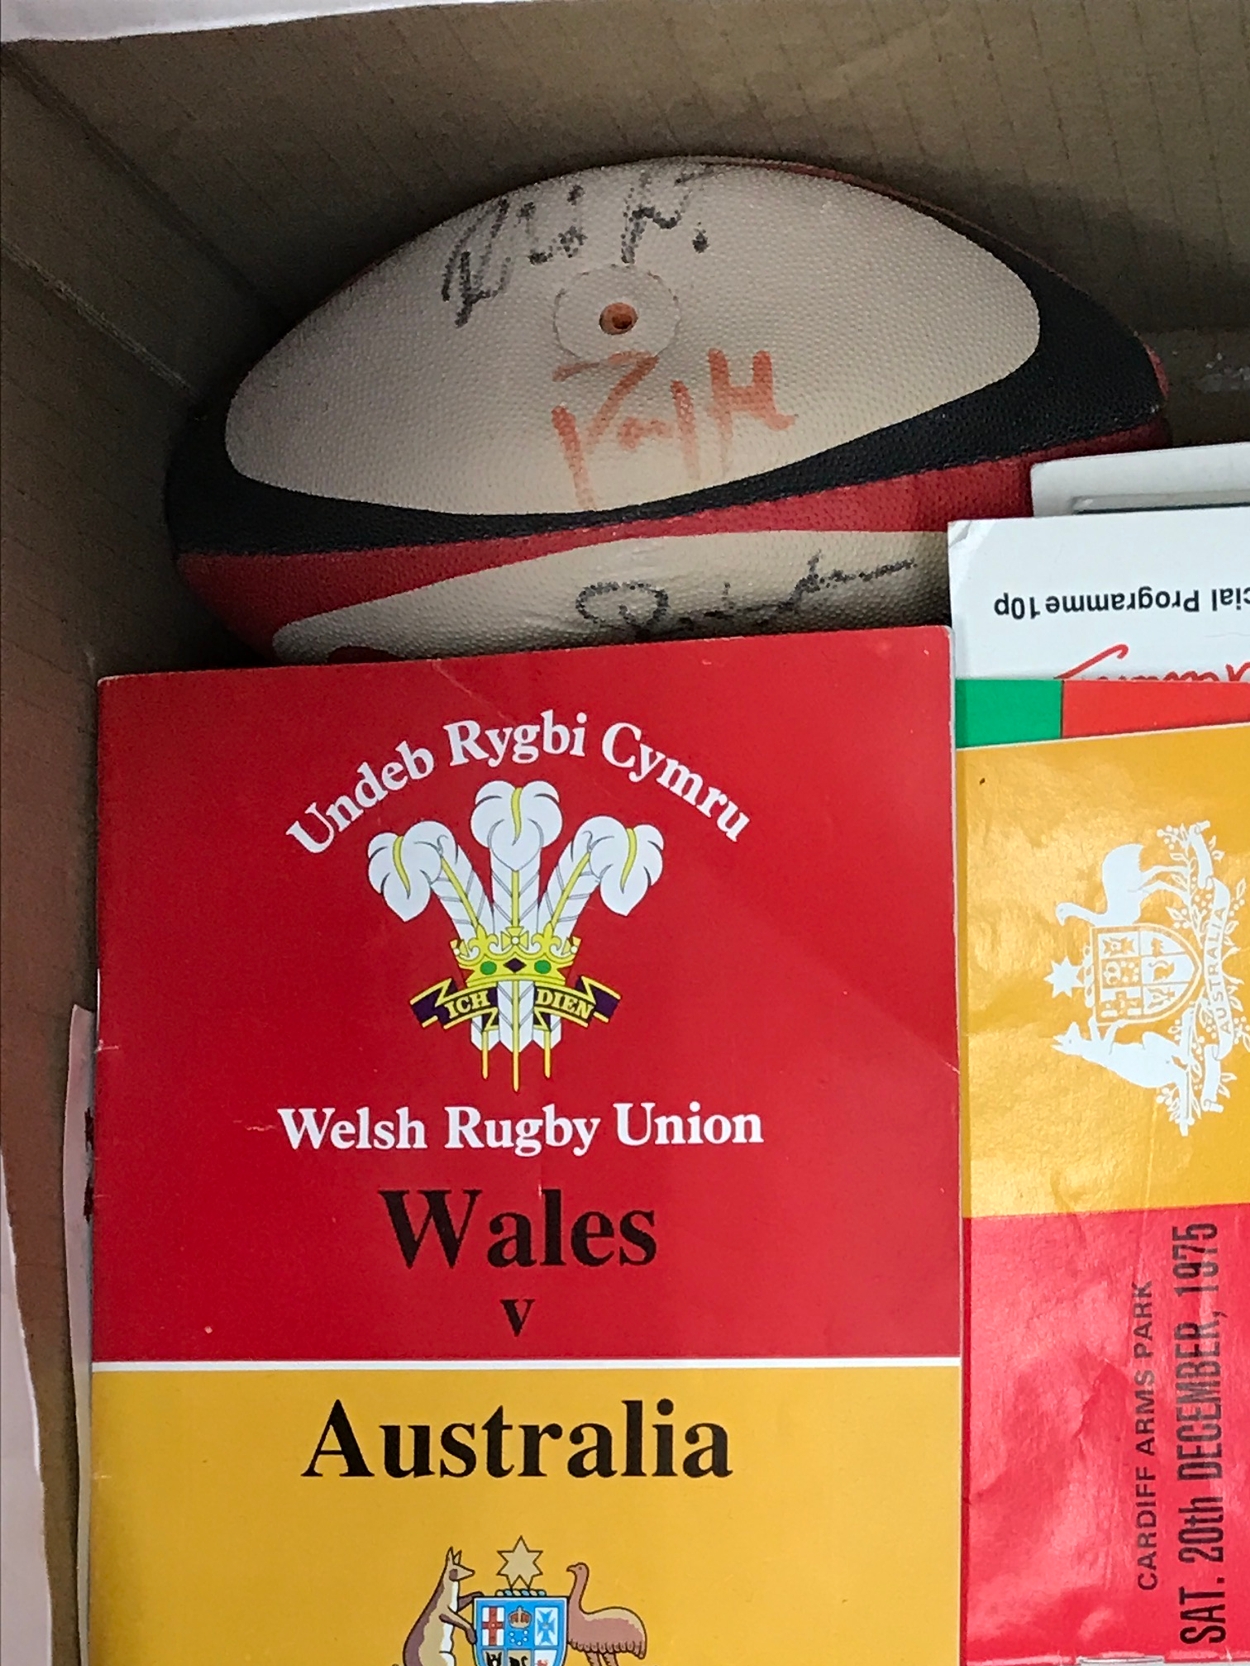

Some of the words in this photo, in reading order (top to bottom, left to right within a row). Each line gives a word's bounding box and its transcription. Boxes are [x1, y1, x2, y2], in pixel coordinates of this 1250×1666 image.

[286, 737, 436, 856] Undeb
[443, 709, 588, 767] Rygbi
[600, 720, 752, 842] Cymru
[448, 991, 490, 1020] ICH
[537, 988, 592, 1020] DIEN
[277, 1107, 427, 1151] Welsh
[444, 1106, 601, 1158] Rugby
[617, 1102, 763, 1146] Union
[378, 1189, 657, 1269] Wales
[1171, 1222, 1219, 1299] 1975
[500, 1299, 535, 1337] v
[1132, 1281, 1153, 1363] PARK
[1134, 1370, 1156, 1457] ARMS
[1174, 1309, 1230, 1482] DECEMBER,
[300, 1396, 734, 1480] Australia
[1136, 1460, 1159, 1592] CARDIFF
[1178, 1485, 1225, 1568] 20th
[1180, 1577, 1226, 1645] SAT.
